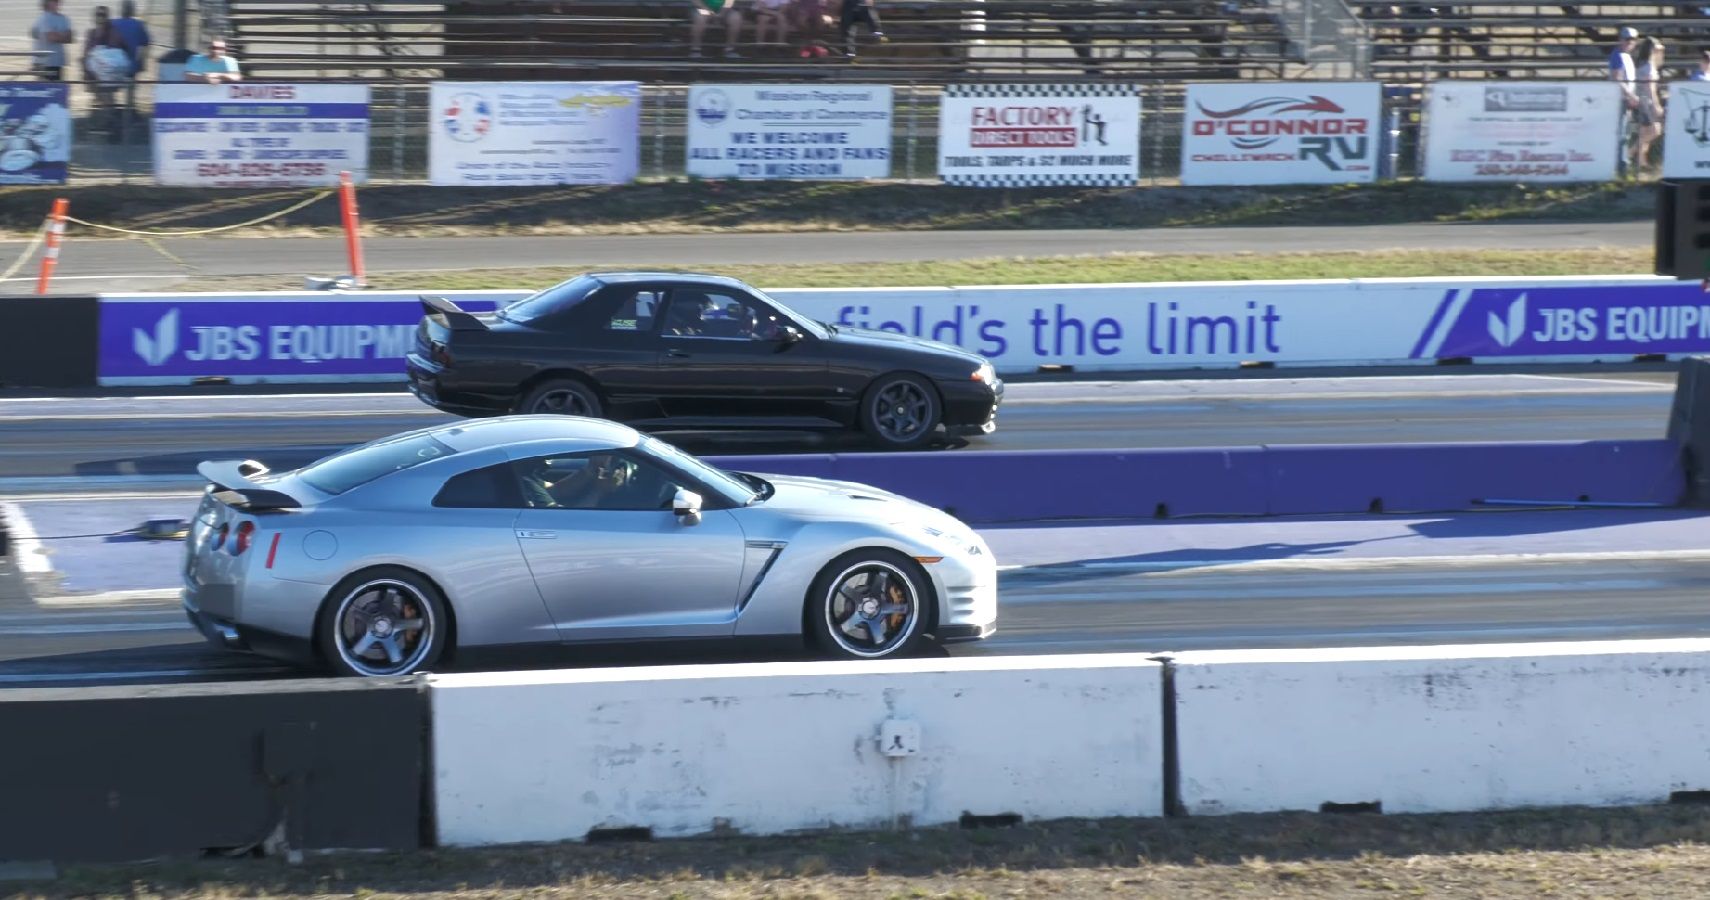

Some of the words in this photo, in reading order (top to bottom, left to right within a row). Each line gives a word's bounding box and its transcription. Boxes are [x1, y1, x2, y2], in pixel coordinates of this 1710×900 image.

[971, 106, 1075, 126] FACTORY
[1192, 118, 1369, 136] O'CONNOR
[730, 132, 757, 144] WE
[763, 132, 849, 144] WELCOME
[972, 130, 1024, 145] DIRECT
[1027, 130, 1075, 145] TOOLS
[689, 147, 722, 160] ALL
[726, 147, 799, 160] RACERS
[802, 147, 839, 160] AND
[842, 147, 890, 160] FANS
[1060, 155, 1094, 166] MUCH
[1098, 155, 1132, 166] MORE
[1298, 136, 1370, 171] RV
[736, 163, 761, 175] TO
[765, 163, 843, 175] MISSION
[1029, 303, 1124, 357] the
[1147, 301, 1282, 355] limit
[1532, 307, 1599, 342] JBS
[185, 325, 261, 362] JBS
